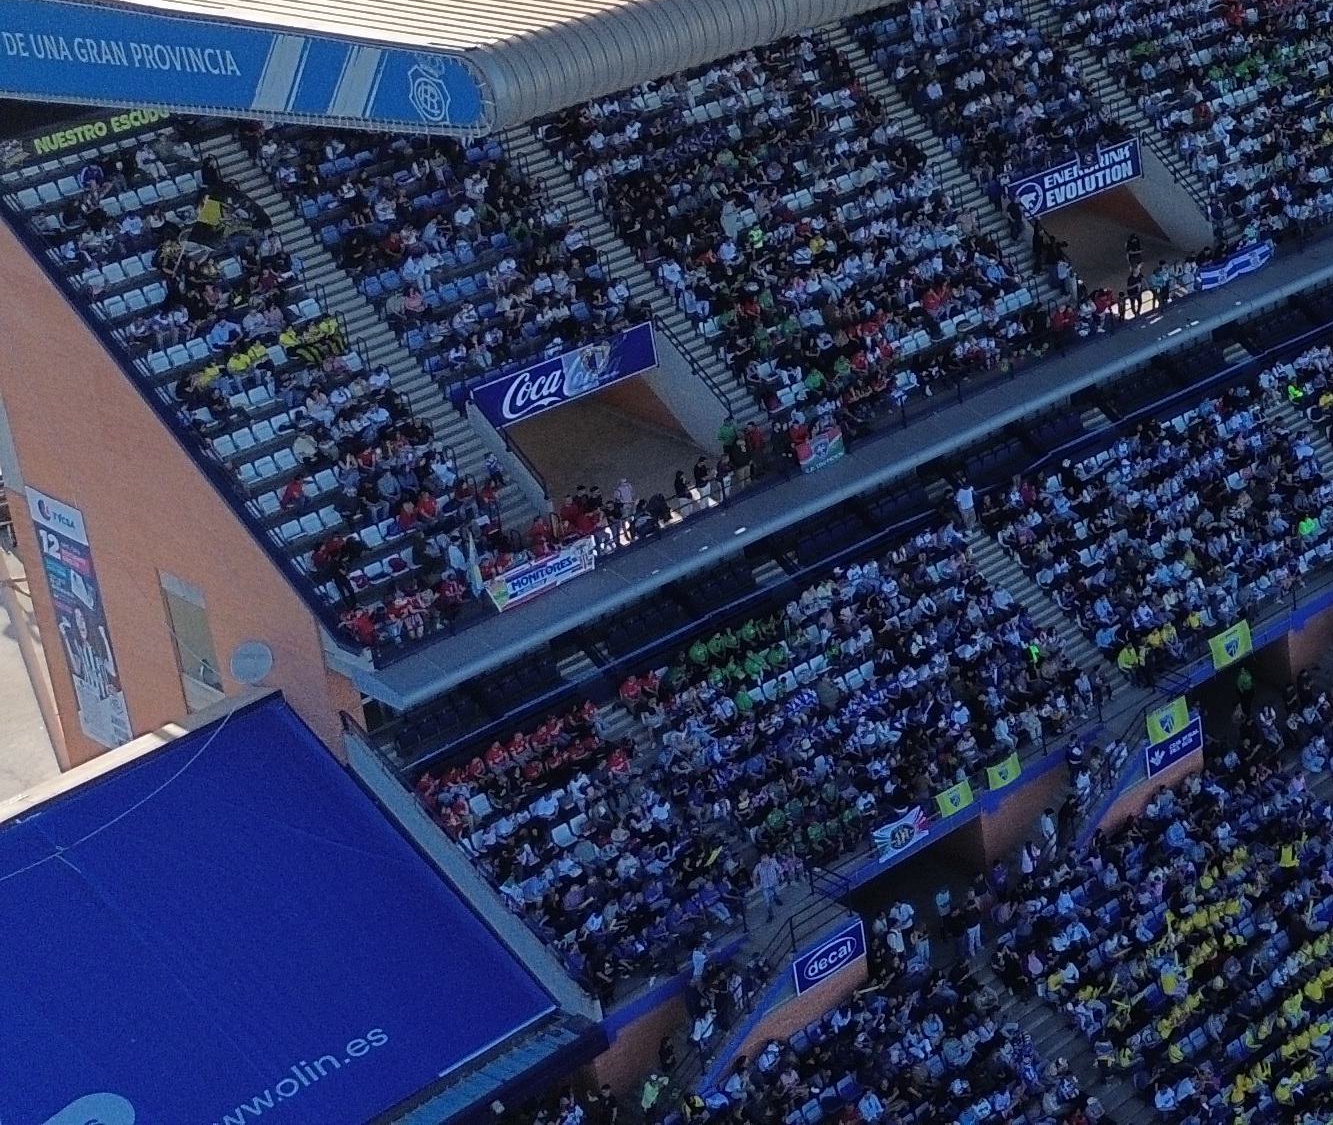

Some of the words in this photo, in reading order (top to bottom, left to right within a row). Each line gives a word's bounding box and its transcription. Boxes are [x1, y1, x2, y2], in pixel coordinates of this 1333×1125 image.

[4, 32, 30, 57] DE
[32, 35, 73, 62] UNA
[74, 38, 128, 67] GRAN
[130, 43, 242, 76] PROVINCIA
[34, 121, 108, 155] NUESTRO
[1045, 160, 1133, 208] EVOLUTION
[40, 529, 62, 560] 12
[511, 556, 573, 592] MONITORES
[807, 940, 853, 977] decal
[213, 1027, 389, 1125] ww.olin.es
